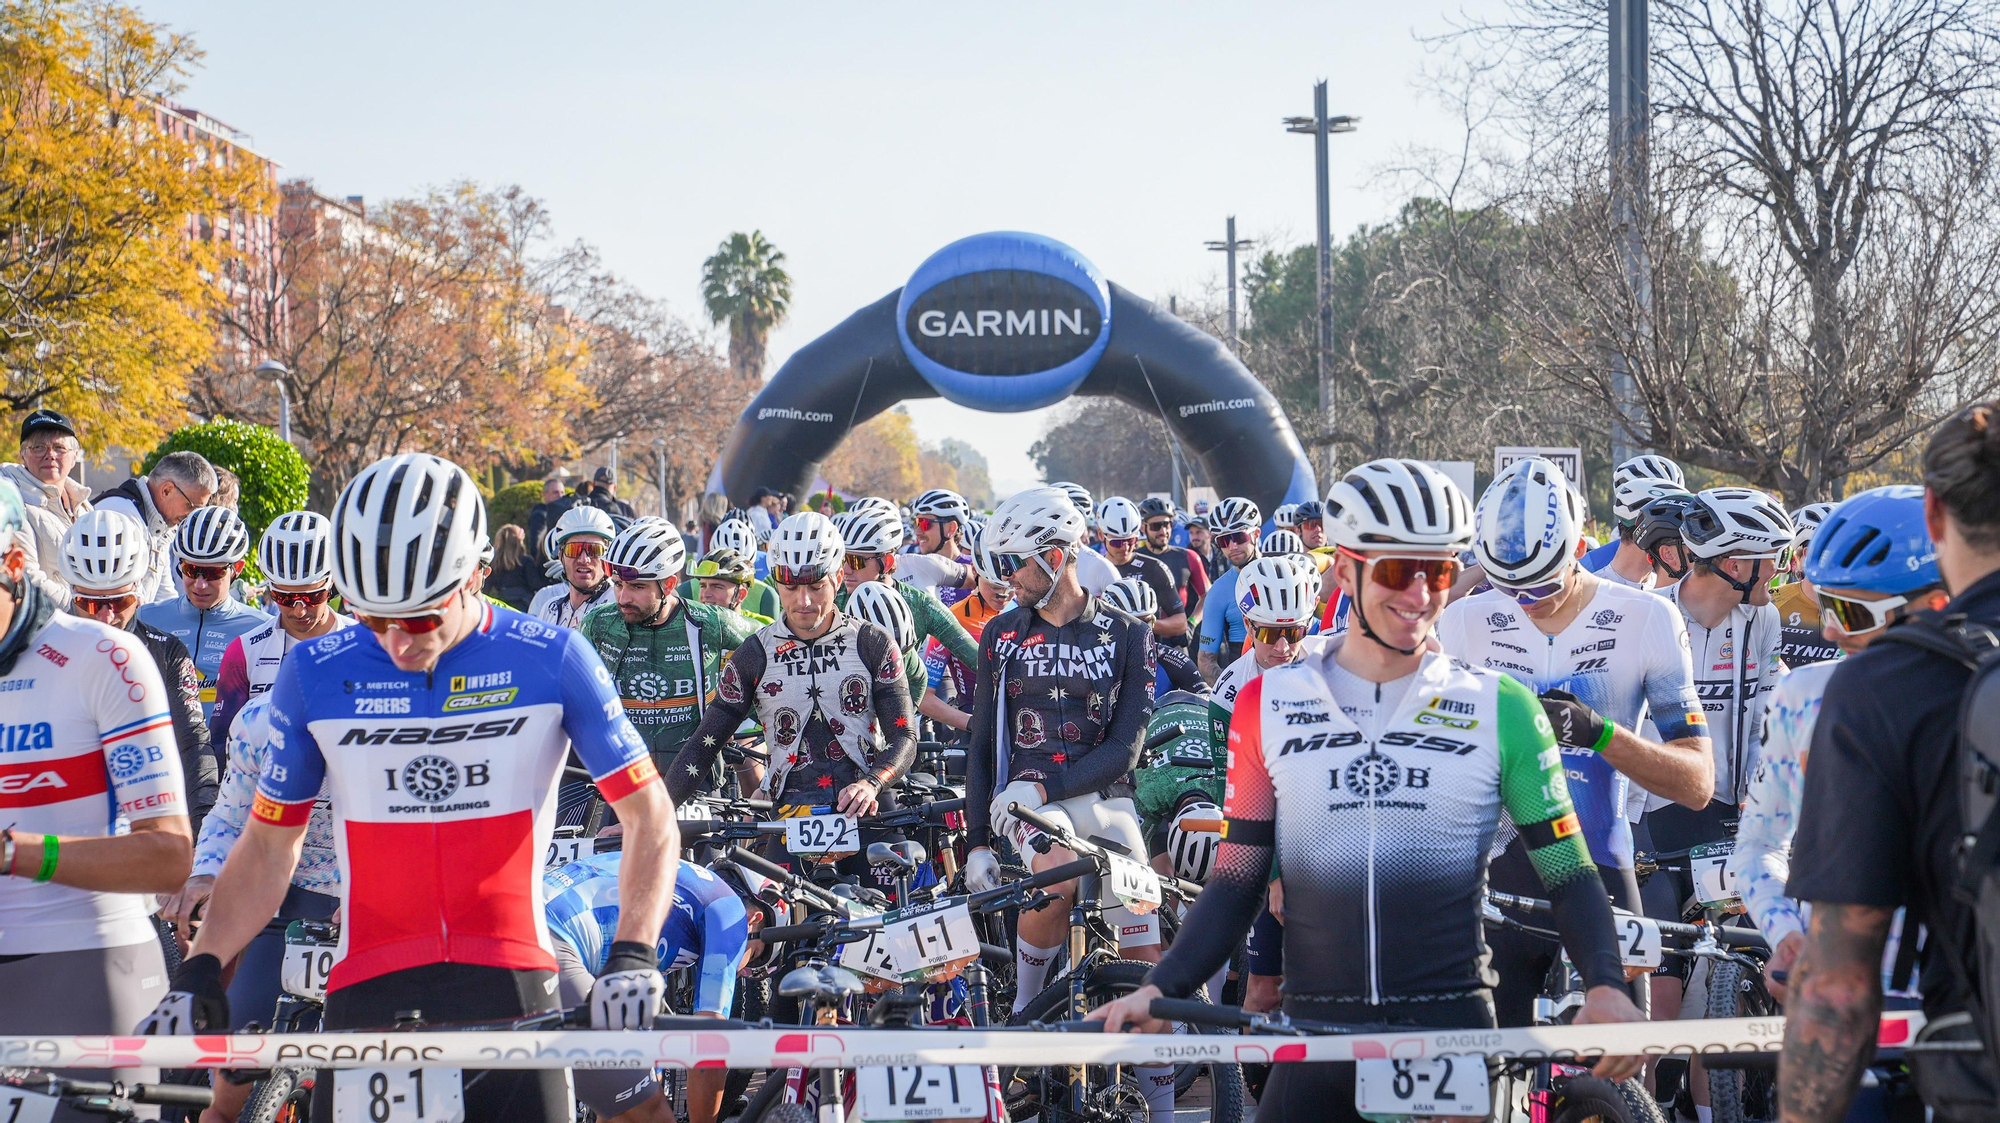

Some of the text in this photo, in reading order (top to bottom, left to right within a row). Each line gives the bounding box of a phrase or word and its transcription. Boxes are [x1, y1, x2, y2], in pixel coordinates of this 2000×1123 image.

[918, 308, 1084, 338] GARMIN
[757, 406, 834, 423] garmin.com
[1179, 397, 1256, 418] garmin.com
[1542, 480, 1558, 549] RUDY
[1036, 528, 1056, 545] ABUS
[1730, 531, 1771, 543] SCOTT
[673, 654, 692, 662] BIKE
[773, 644, 848, 664] FACTORY
[1166, 648, 1191, 664] TRUE
[1576, 643, 1597, 656] UCI
[1781, 643, 1842, 659] EYNICE
[784, 656, 841, 677] TEAM
[924, 655, 945, 671] B2P
[1493, 659, 1534, 675] TABROS
[1571, 668, 1610, 678] MANITOU
[354, 696, 412, 715] 226ERS
[448, 691, 511, 709] GALFER
[663, 706, 693, 715] TEAM
[388, 799, 491, 815] SPORT BEARINGS
[798, 816, 850, 848] 52-2
[1711, 858, 1737, 892] 7-
[907, 915, 953, 959] 1-1
[1615, 919, 1647, 958] -2
[928, 954, 949, 964] PORRO
[1391, 1058, 1457, 1101] 8-2
[369, 1067, 426, 1123] 8-1
